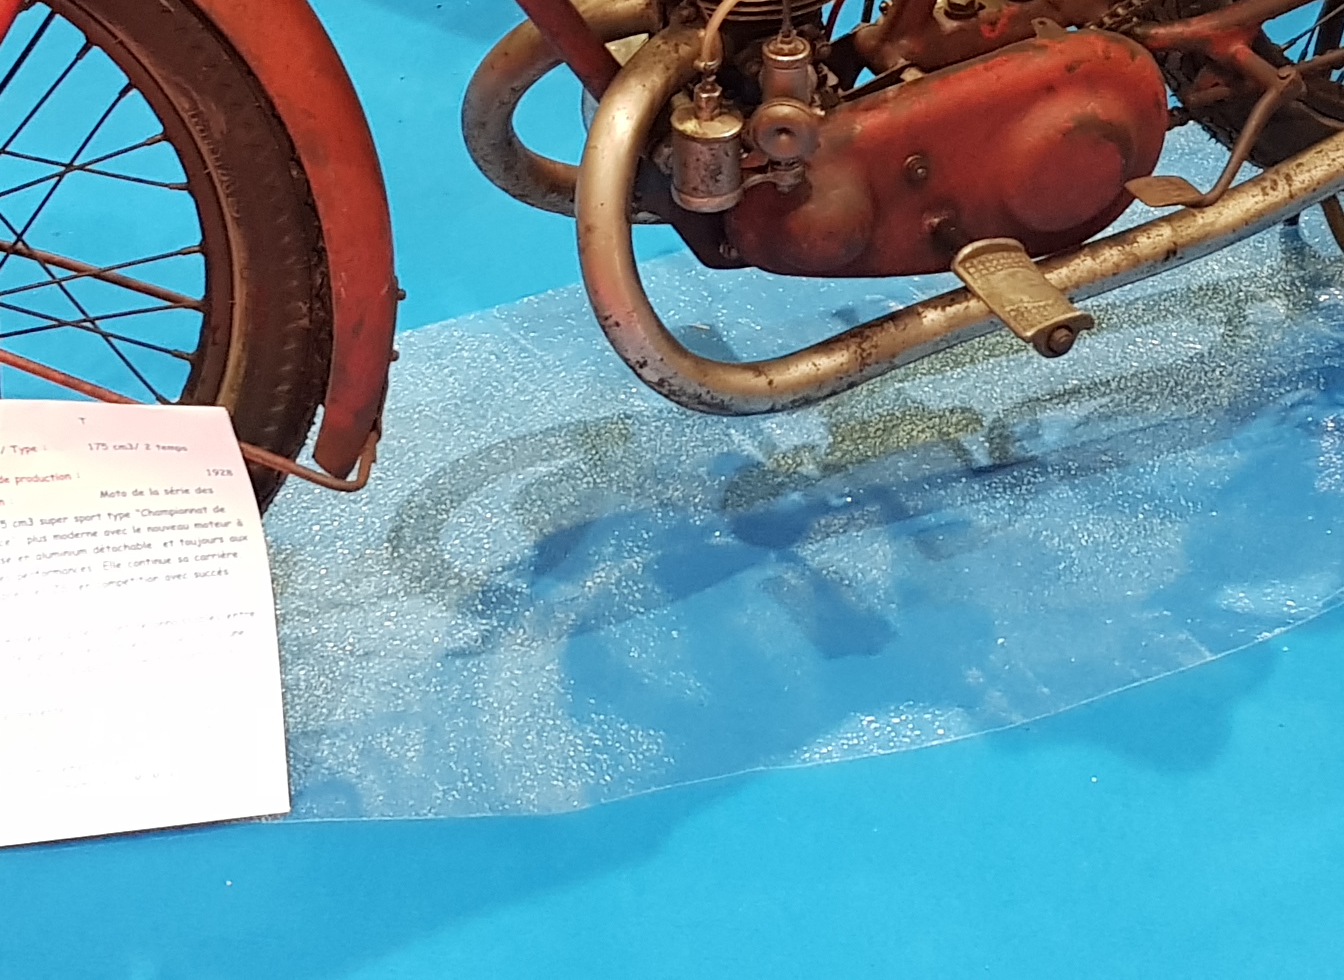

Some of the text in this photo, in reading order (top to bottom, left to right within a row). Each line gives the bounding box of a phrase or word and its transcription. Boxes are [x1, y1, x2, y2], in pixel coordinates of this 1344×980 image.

[9, 444, 38, 456] Type
[15, 473, 72, 487] production
[99, 486, 214, 499] Moto de la série des
[39, 516, 69, 526] super
[74, 513, 102, 524] sport
[107, 511, 131, 522] type
[212, 505, 226, 514] de
[27, 535, 48, 545] plus
[52, 530, 98, 540] moderne
[103, 528, 128, 537] avec
[132, 525, 142, 534] le
[147, 523, 190, 533] nouveau
[194, 520, 232, 530] moteur
